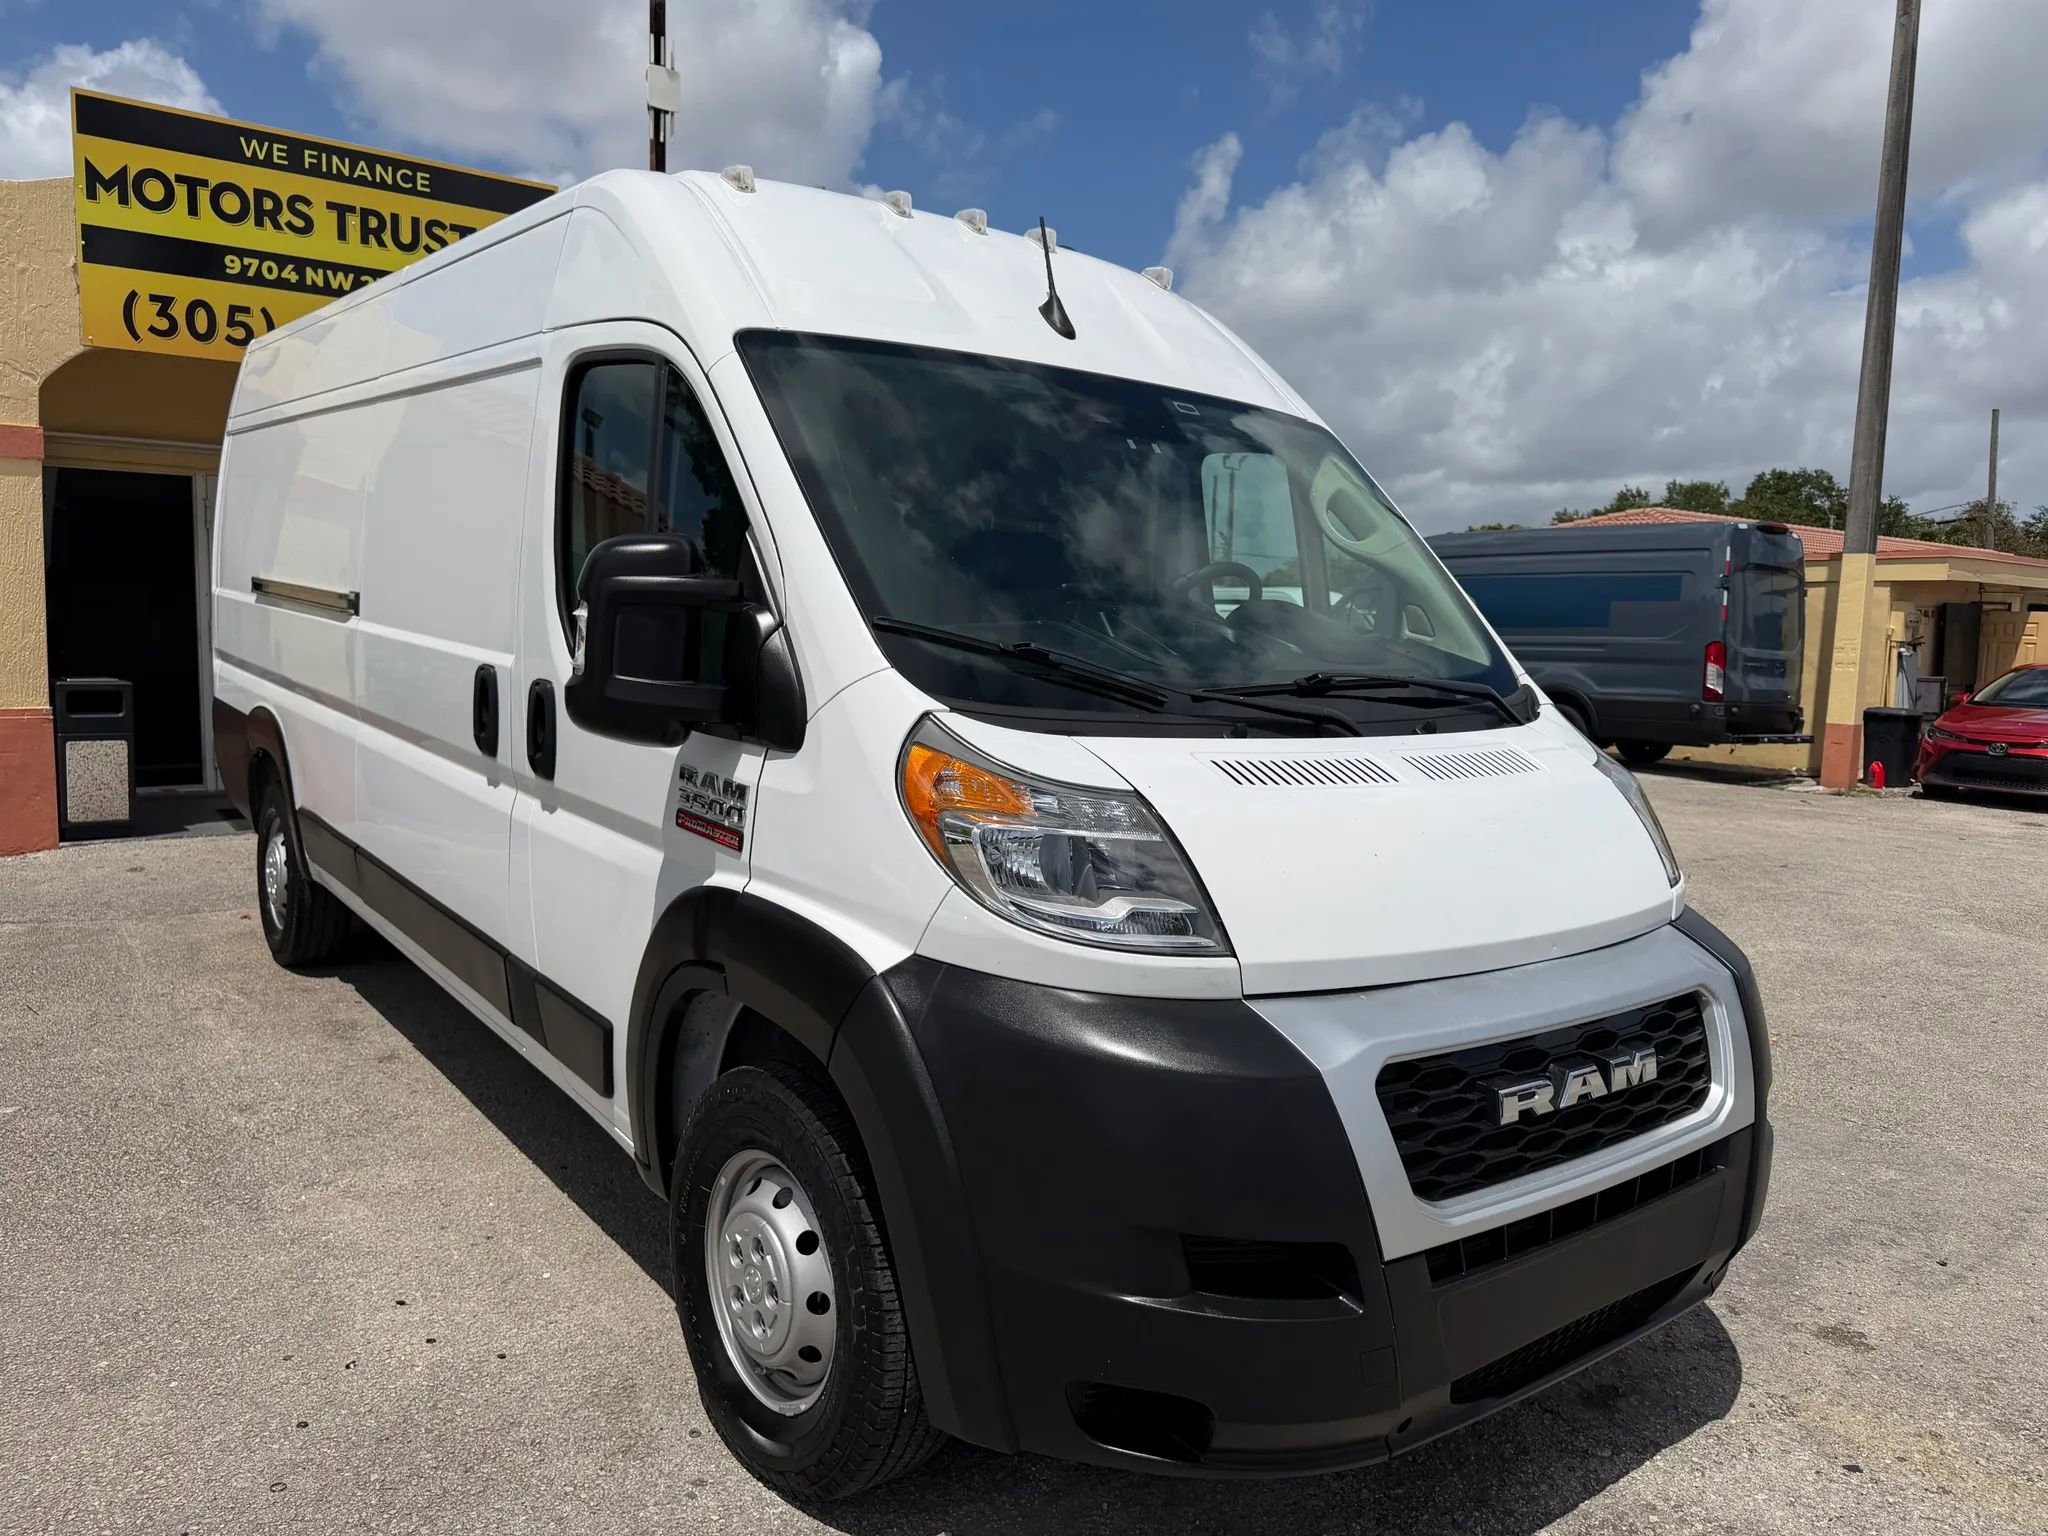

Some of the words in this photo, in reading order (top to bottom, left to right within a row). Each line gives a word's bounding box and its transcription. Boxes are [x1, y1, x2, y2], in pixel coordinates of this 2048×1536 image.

[240, 136, 288, 165] WE
[304, 149, 431, 192] FINANCE
[84, 156, 315, 237] MOTORS
[224, 254, 299, 284] 9704
[305, 266, 354, 292] NW
[679, 763, 750, 809] RAM
[1499, 1046, 1657, 1127] RAM
